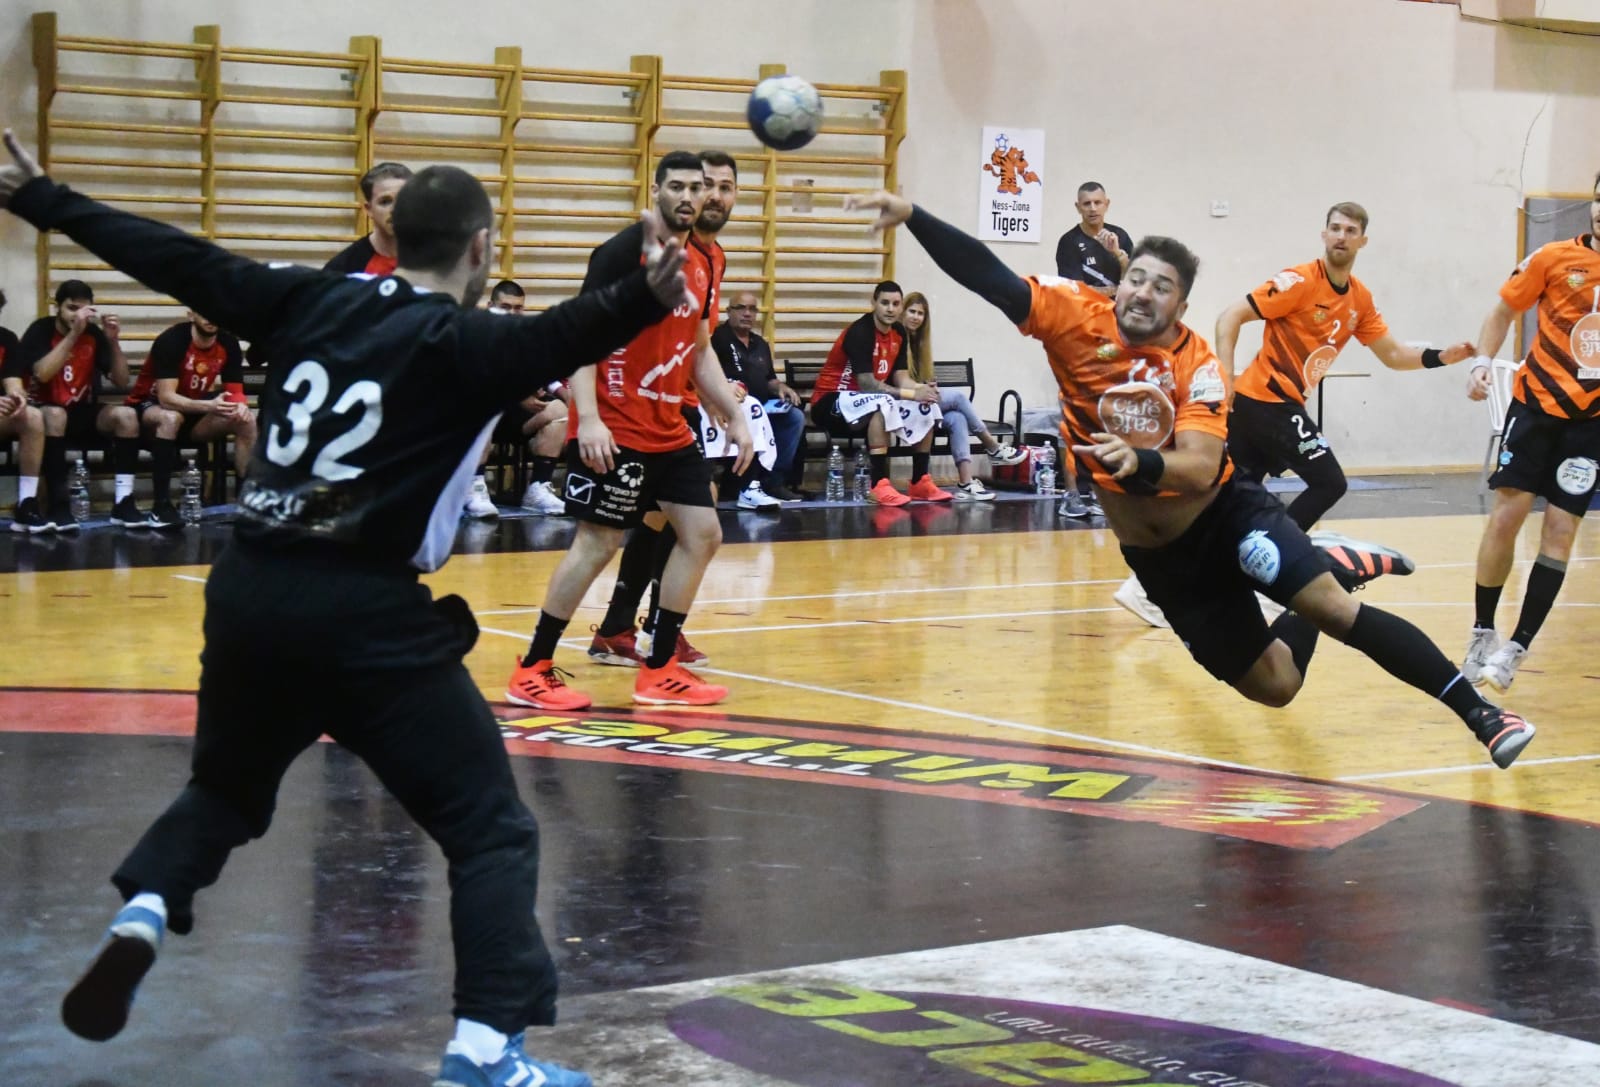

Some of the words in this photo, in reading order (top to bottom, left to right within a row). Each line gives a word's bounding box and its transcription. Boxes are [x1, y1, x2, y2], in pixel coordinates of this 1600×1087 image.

[992, 199, 1030, 212] Ness-Ziona
[992, 211, 1029, 236] Tigers
[1327, 319, 1341, 345] 2
[63, 365, 74, 382] 8
[877, 359, 889, 374] 20
[190, 374, 208, 391] 81
[1112, 397, 1160, 418] café
[266, 360, 382, 481] 32
[1291, 415, 1311, 438] 2
